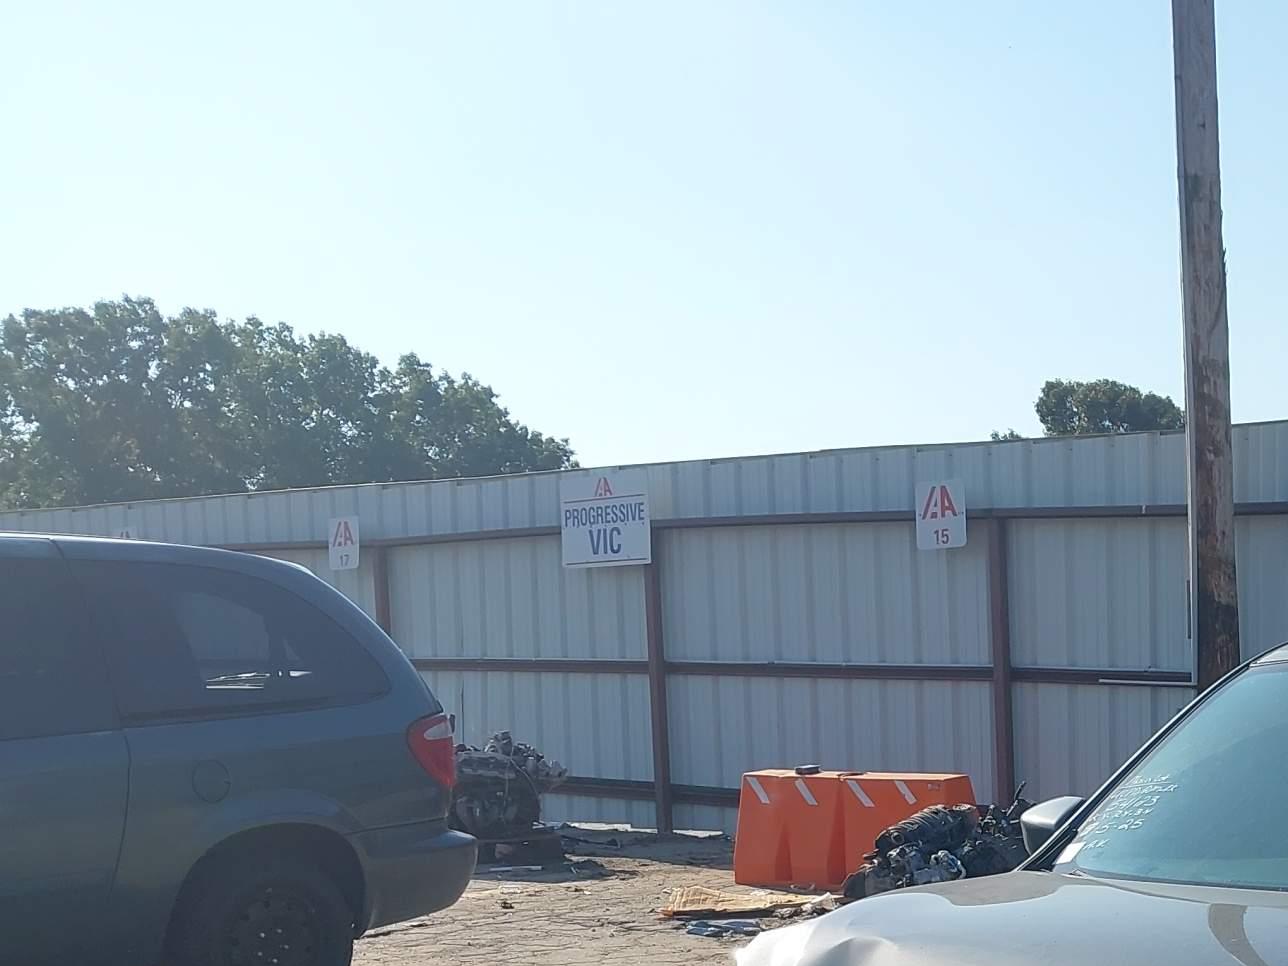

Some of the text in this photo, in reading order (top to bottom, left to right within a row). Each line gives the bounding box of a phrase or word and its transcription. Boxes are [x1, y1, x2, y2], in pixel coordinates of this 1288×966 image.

[564, 502, 645, 528] PROGRESSIVE
[589, 527, 622, 555] VIC
[934, 528, 950, 545] 15
[340, 554, 349, 567] 17
